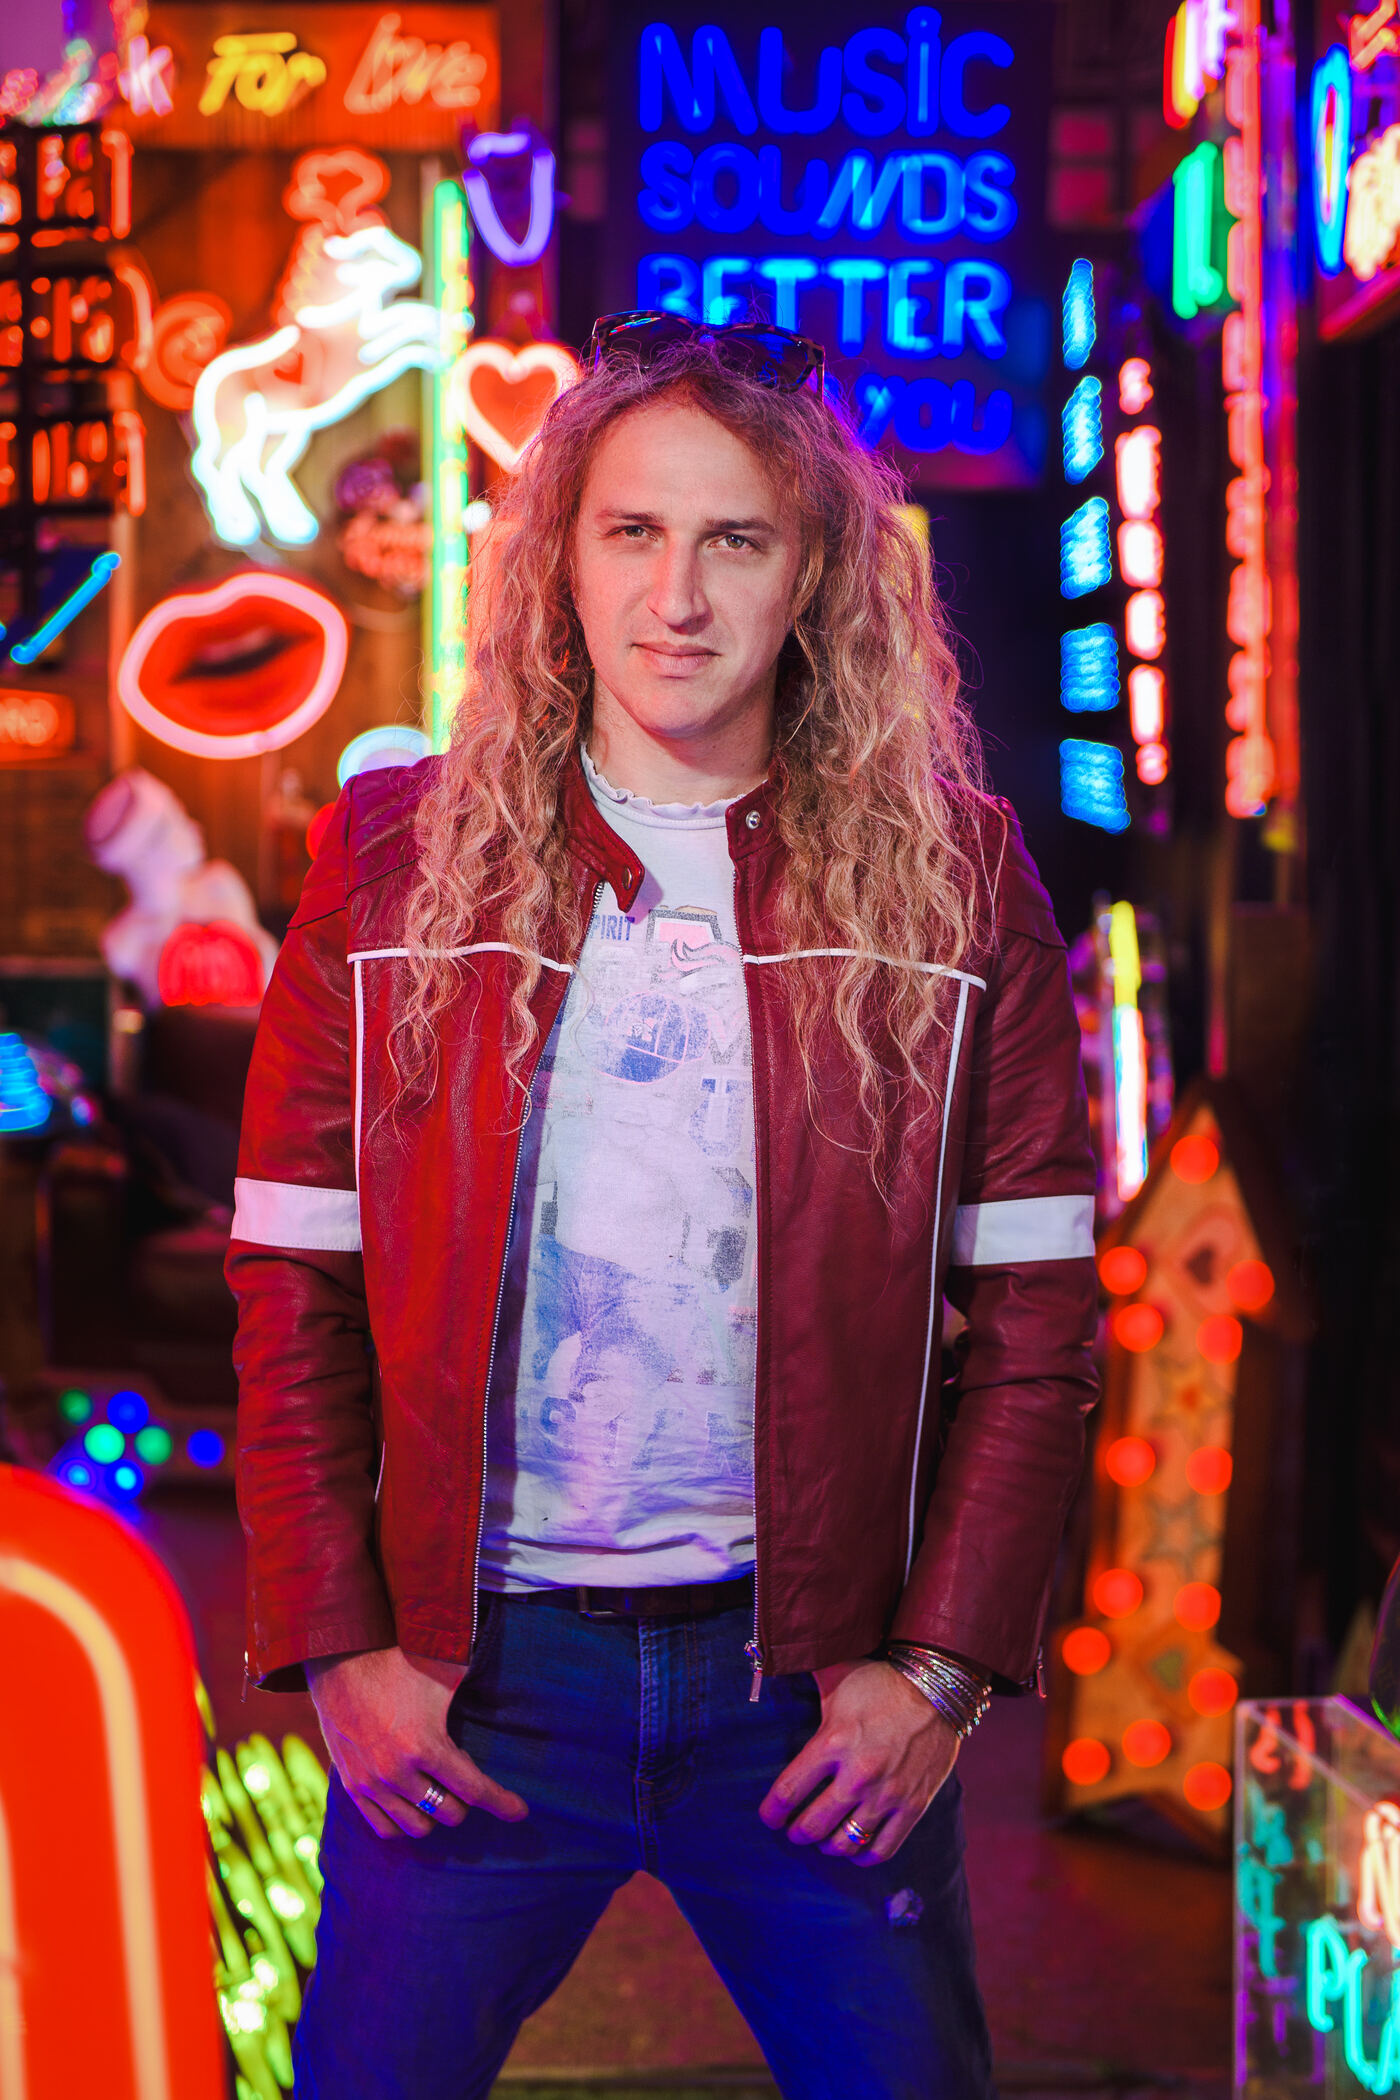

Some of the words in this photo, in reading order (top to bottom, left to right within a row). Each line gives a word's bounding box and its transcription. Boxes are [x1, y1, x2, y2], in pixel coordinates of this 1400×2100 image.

[199, 32, 326, 117] For
[637, 140, 1018, 243] SOUNDS
[636, 252, 1012, 360] BETTER
